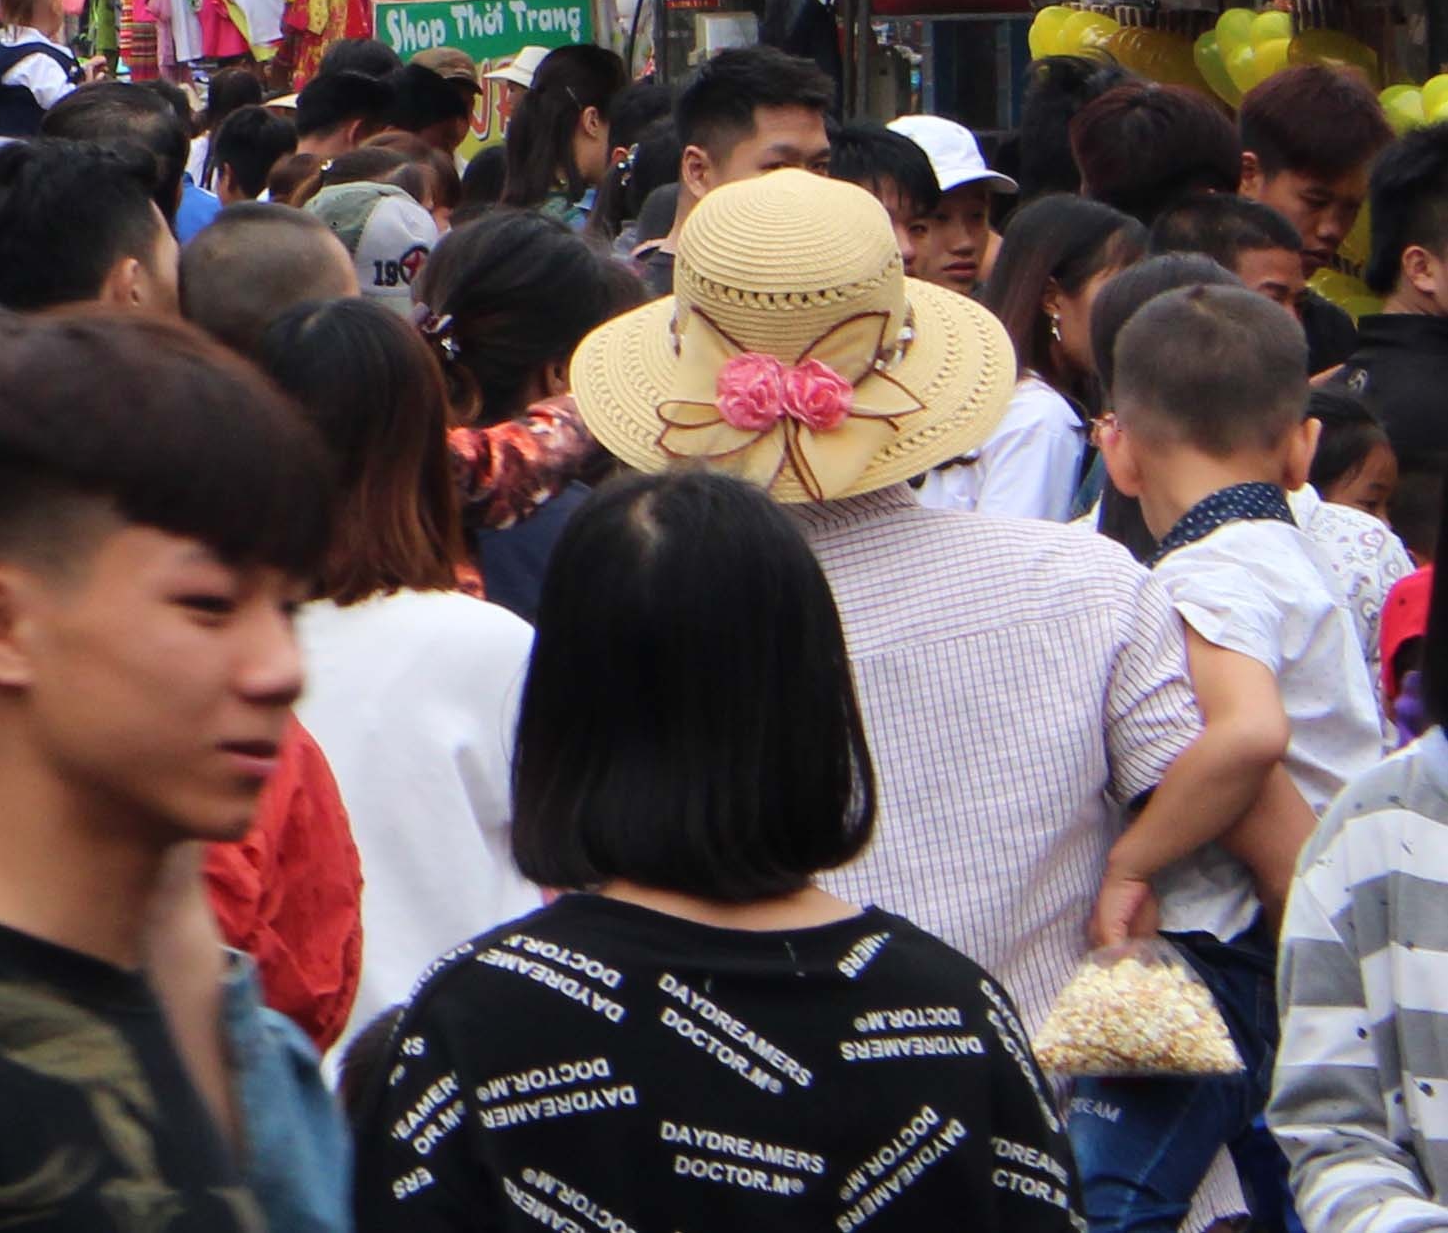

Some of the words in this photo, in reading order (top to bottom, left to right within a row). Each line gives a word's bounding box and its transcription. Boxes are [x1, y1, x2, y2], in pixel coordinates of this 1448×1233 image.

[387, 8, 446, 53] Shop
[451, 1, 503, 39] Thời
[658, 972, 814, 1089] DAYDREAMERS
[840, 1034, 985, 1062] DAYDREAMERS
[660, 1120, 826, 1176] DAYDREAMERS
[836, 1118, 968, 1233] DAYDREAMERS
